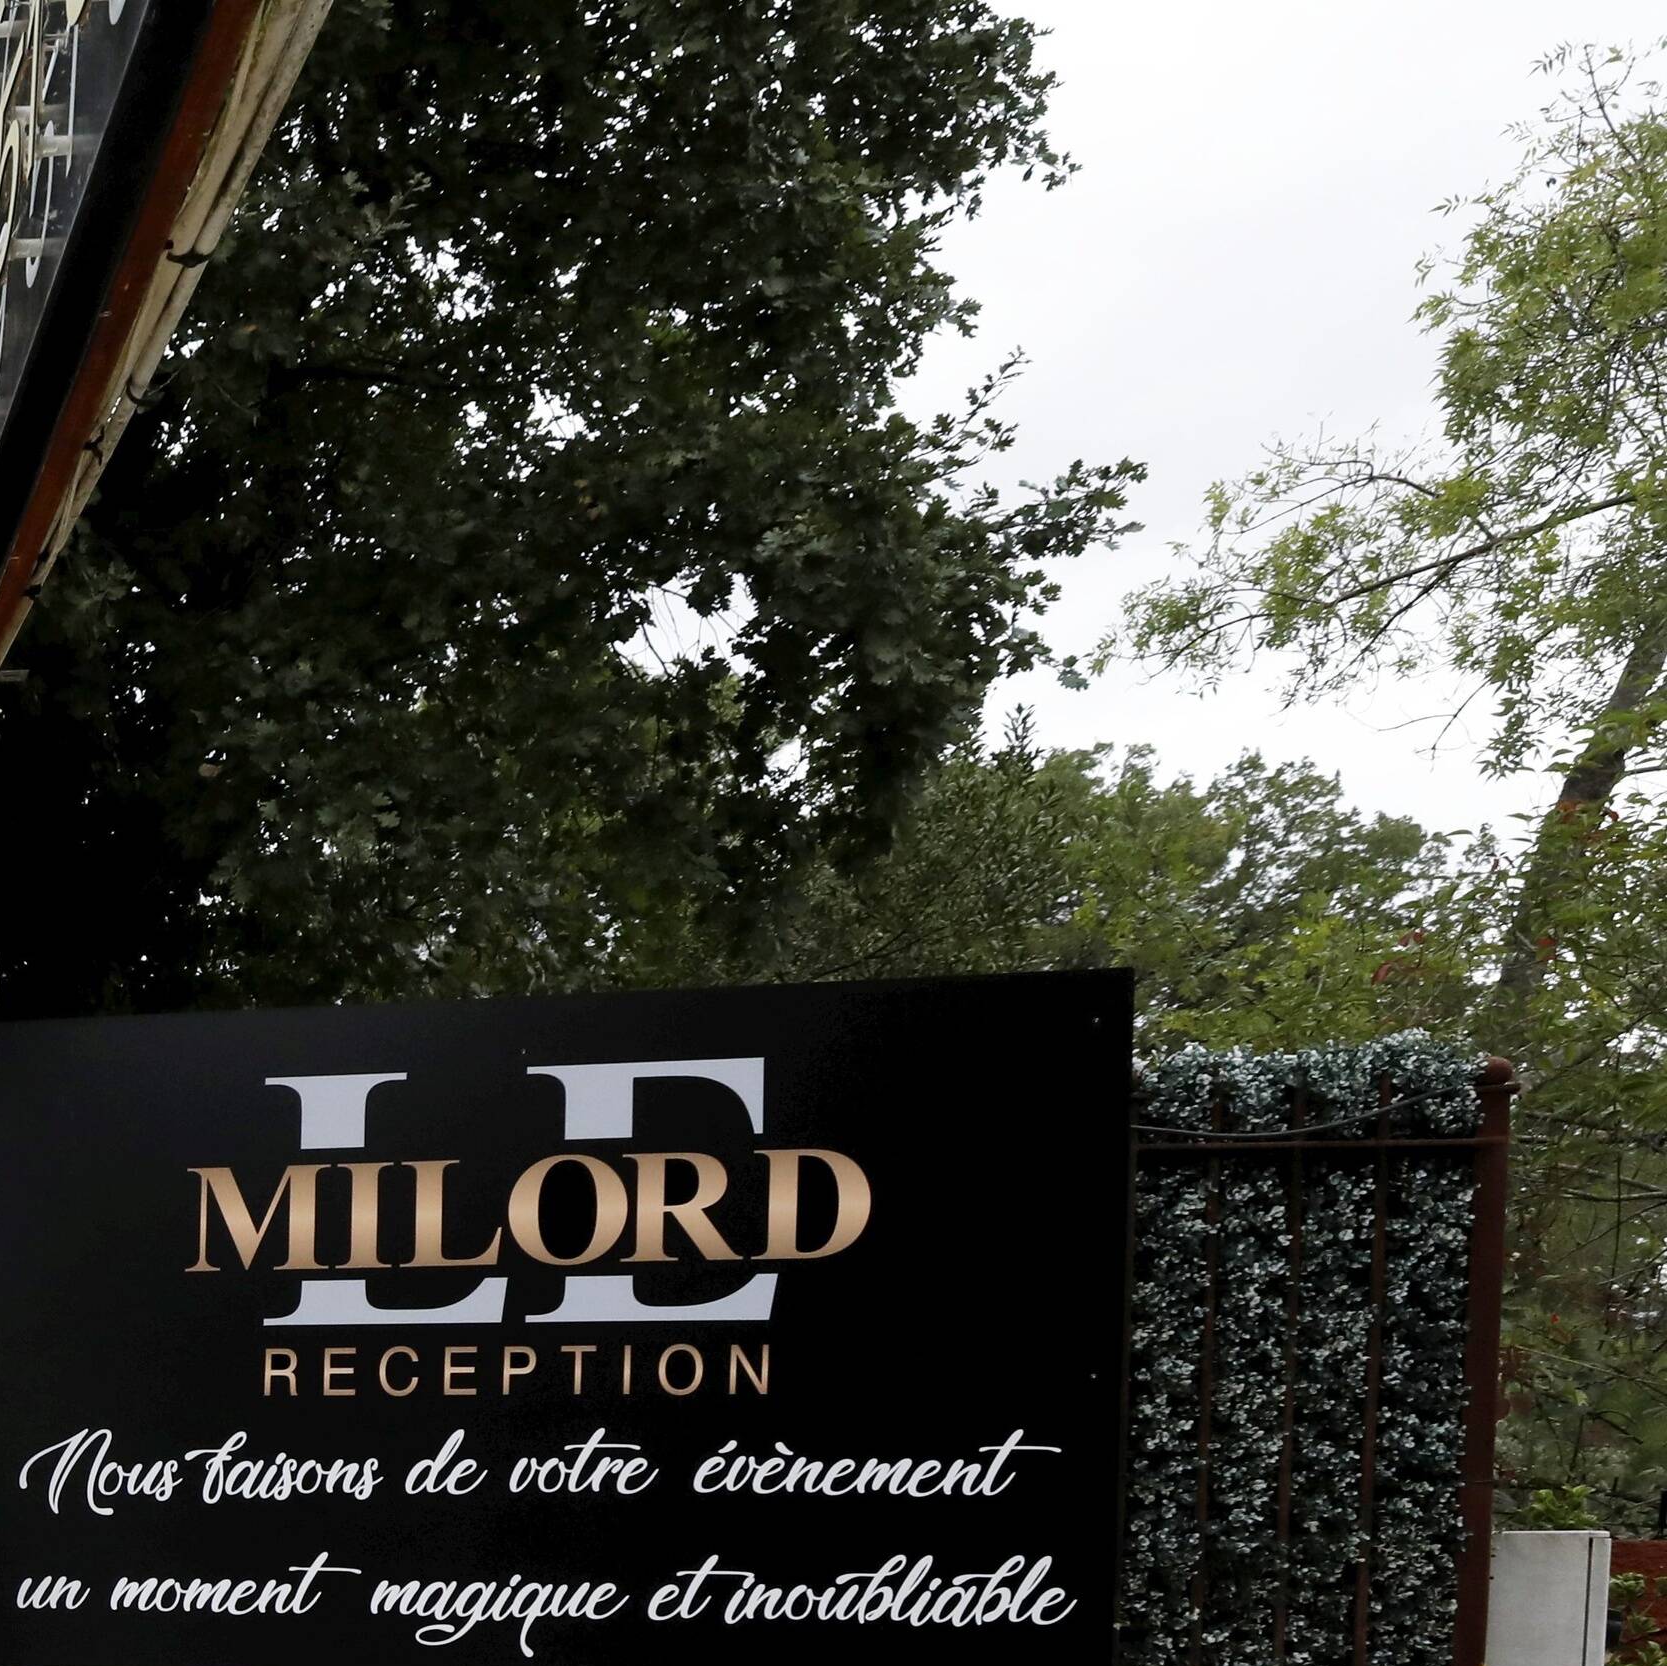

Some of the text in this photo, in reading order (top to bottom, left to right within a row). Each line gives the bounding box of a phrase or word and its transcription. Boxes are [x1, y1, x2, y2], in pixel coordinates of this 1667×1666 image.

[184, 1148, 872, 1272] MILORD
[263, 1057, 779, 1327] LE
[263, 1343, 771, 1397] RECEPTION
[19, 1428, 1062, 1516] Nous faisons de votre évènement
[16, 1551, 1078, 1658] un moment magique et inoubliable
